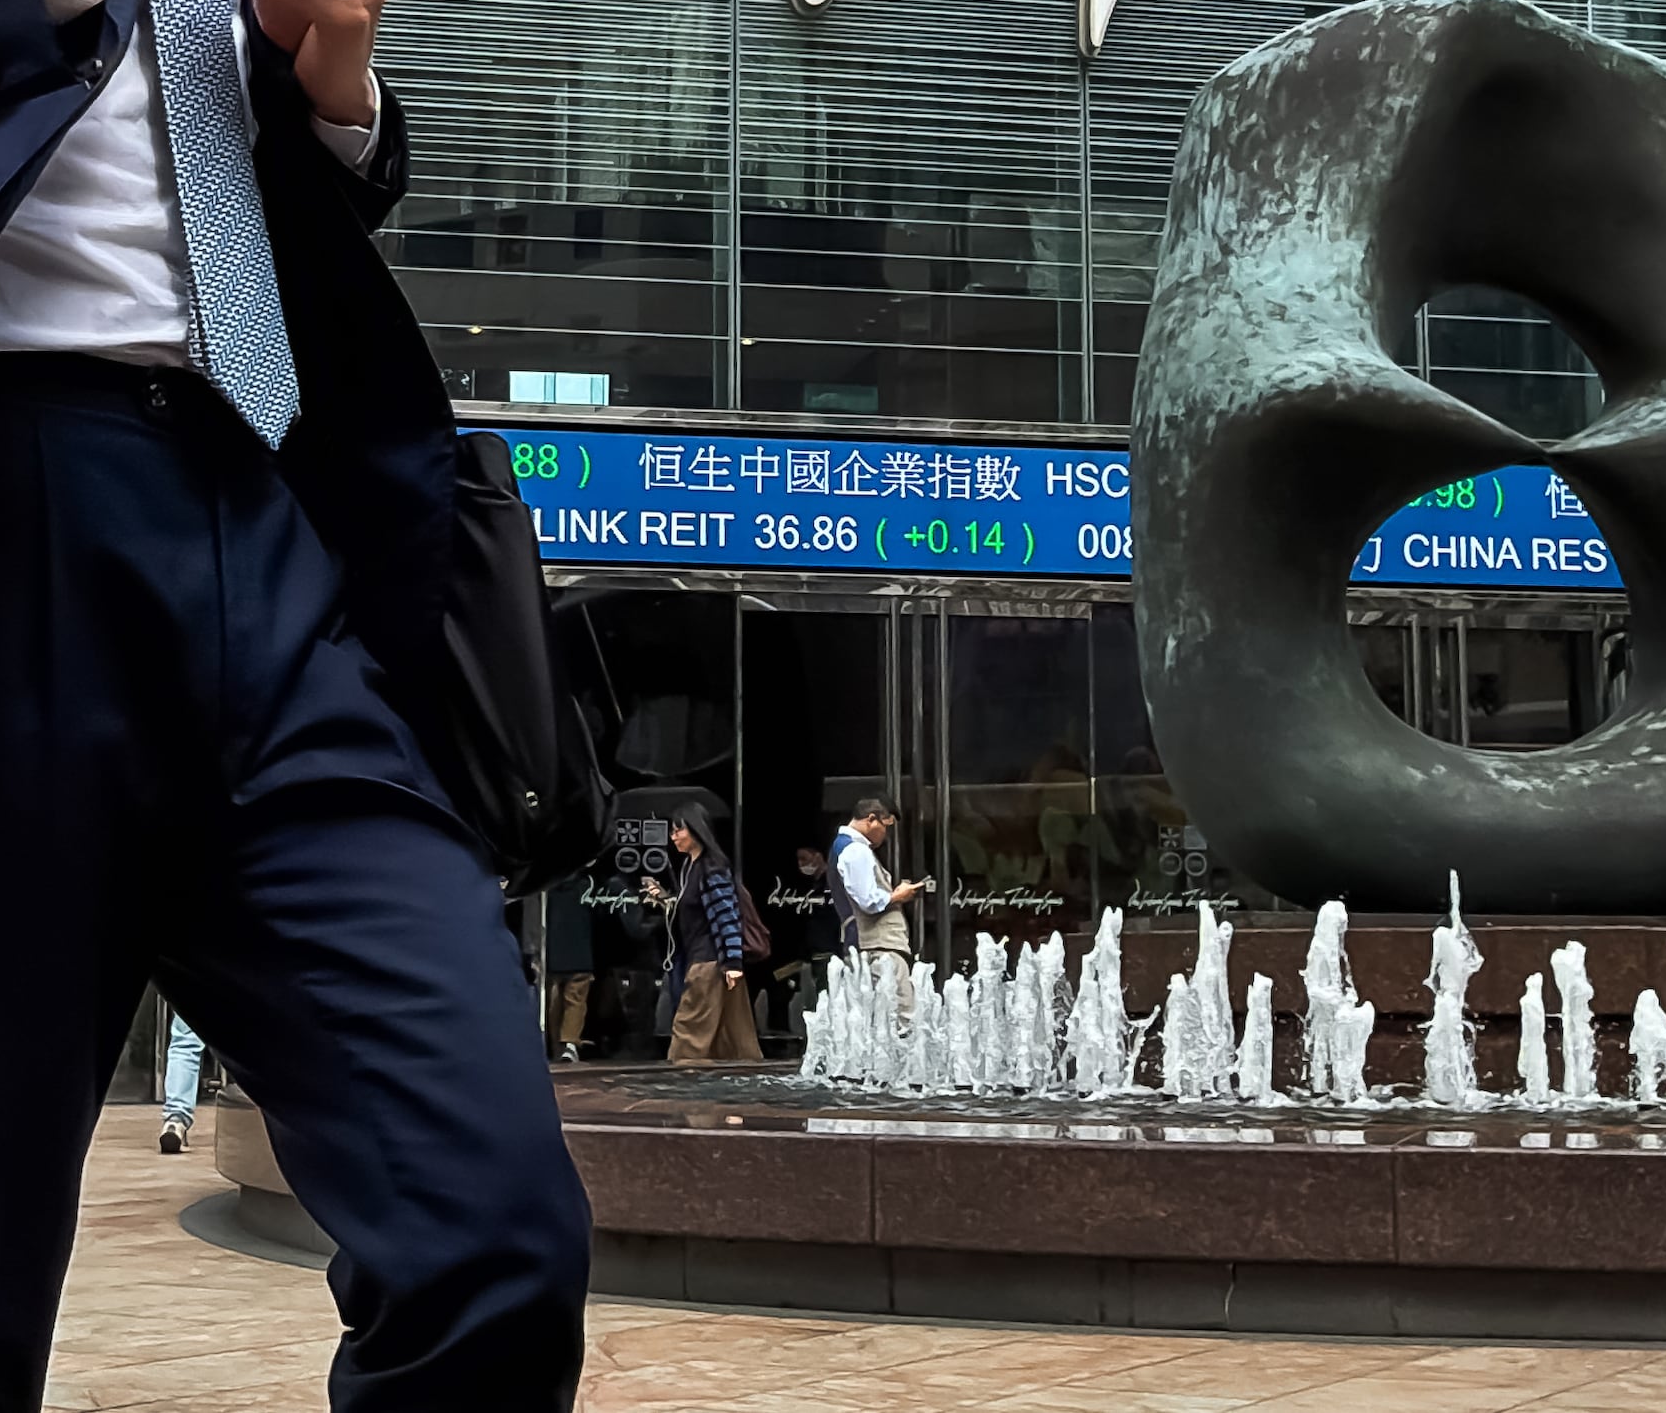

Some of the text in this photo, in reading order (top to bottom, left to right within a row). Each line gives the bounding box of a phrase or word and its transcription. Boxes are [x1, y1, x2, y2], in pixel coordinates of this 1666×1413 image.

[639, 441, 1021, 501] 恒生中國企業指數
[533, 508, 628, 544] LINK
[640, 512, 734, 546] REIT
[755, 514, 857, 551] 36.86
[904, 520, 1005, 554] +0.14
[1404, 534, 1522, 569] CHINA
[1532, 538, 1607, 572] RES
